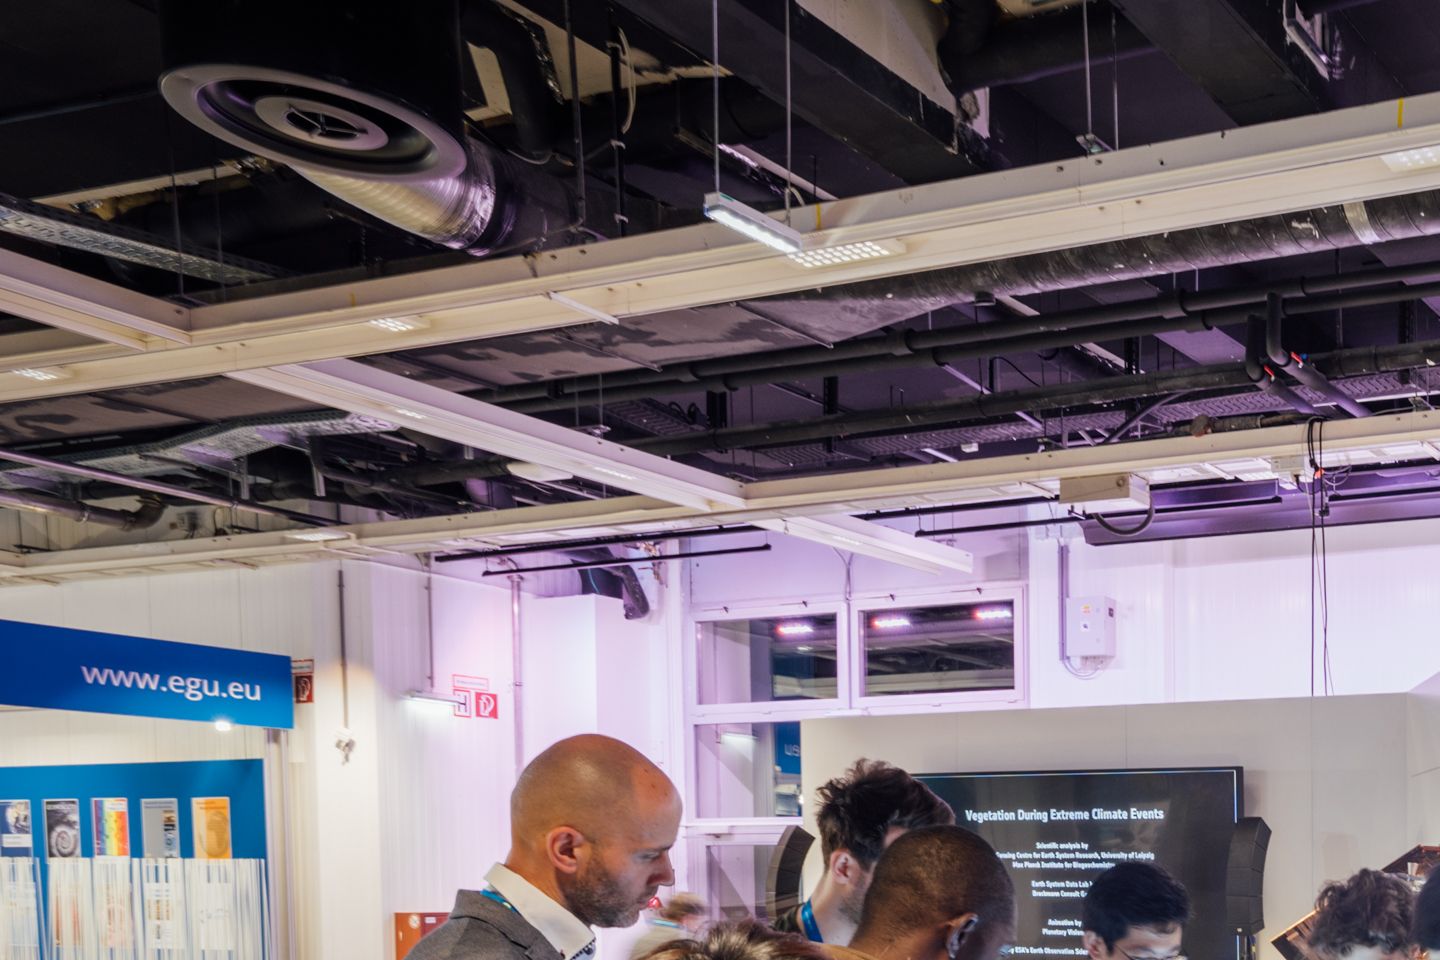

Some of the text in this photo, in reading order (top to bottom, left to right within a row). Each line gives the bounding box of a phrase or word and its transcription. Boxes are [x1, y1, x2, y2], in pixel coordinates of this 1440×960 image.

[81, 665, 261, 701] www.egu.eu
[965, 808, 1164, 823] Vegetation During Extreme Climate Events
[1060, 842, 1080, 850] analysis
[1081, 842, 1089, 850] by
[1056, 851, 1075, 860] System
[1101, 852, 1128, 860] University
[1135, 852, 1155, 860] Leipzig
